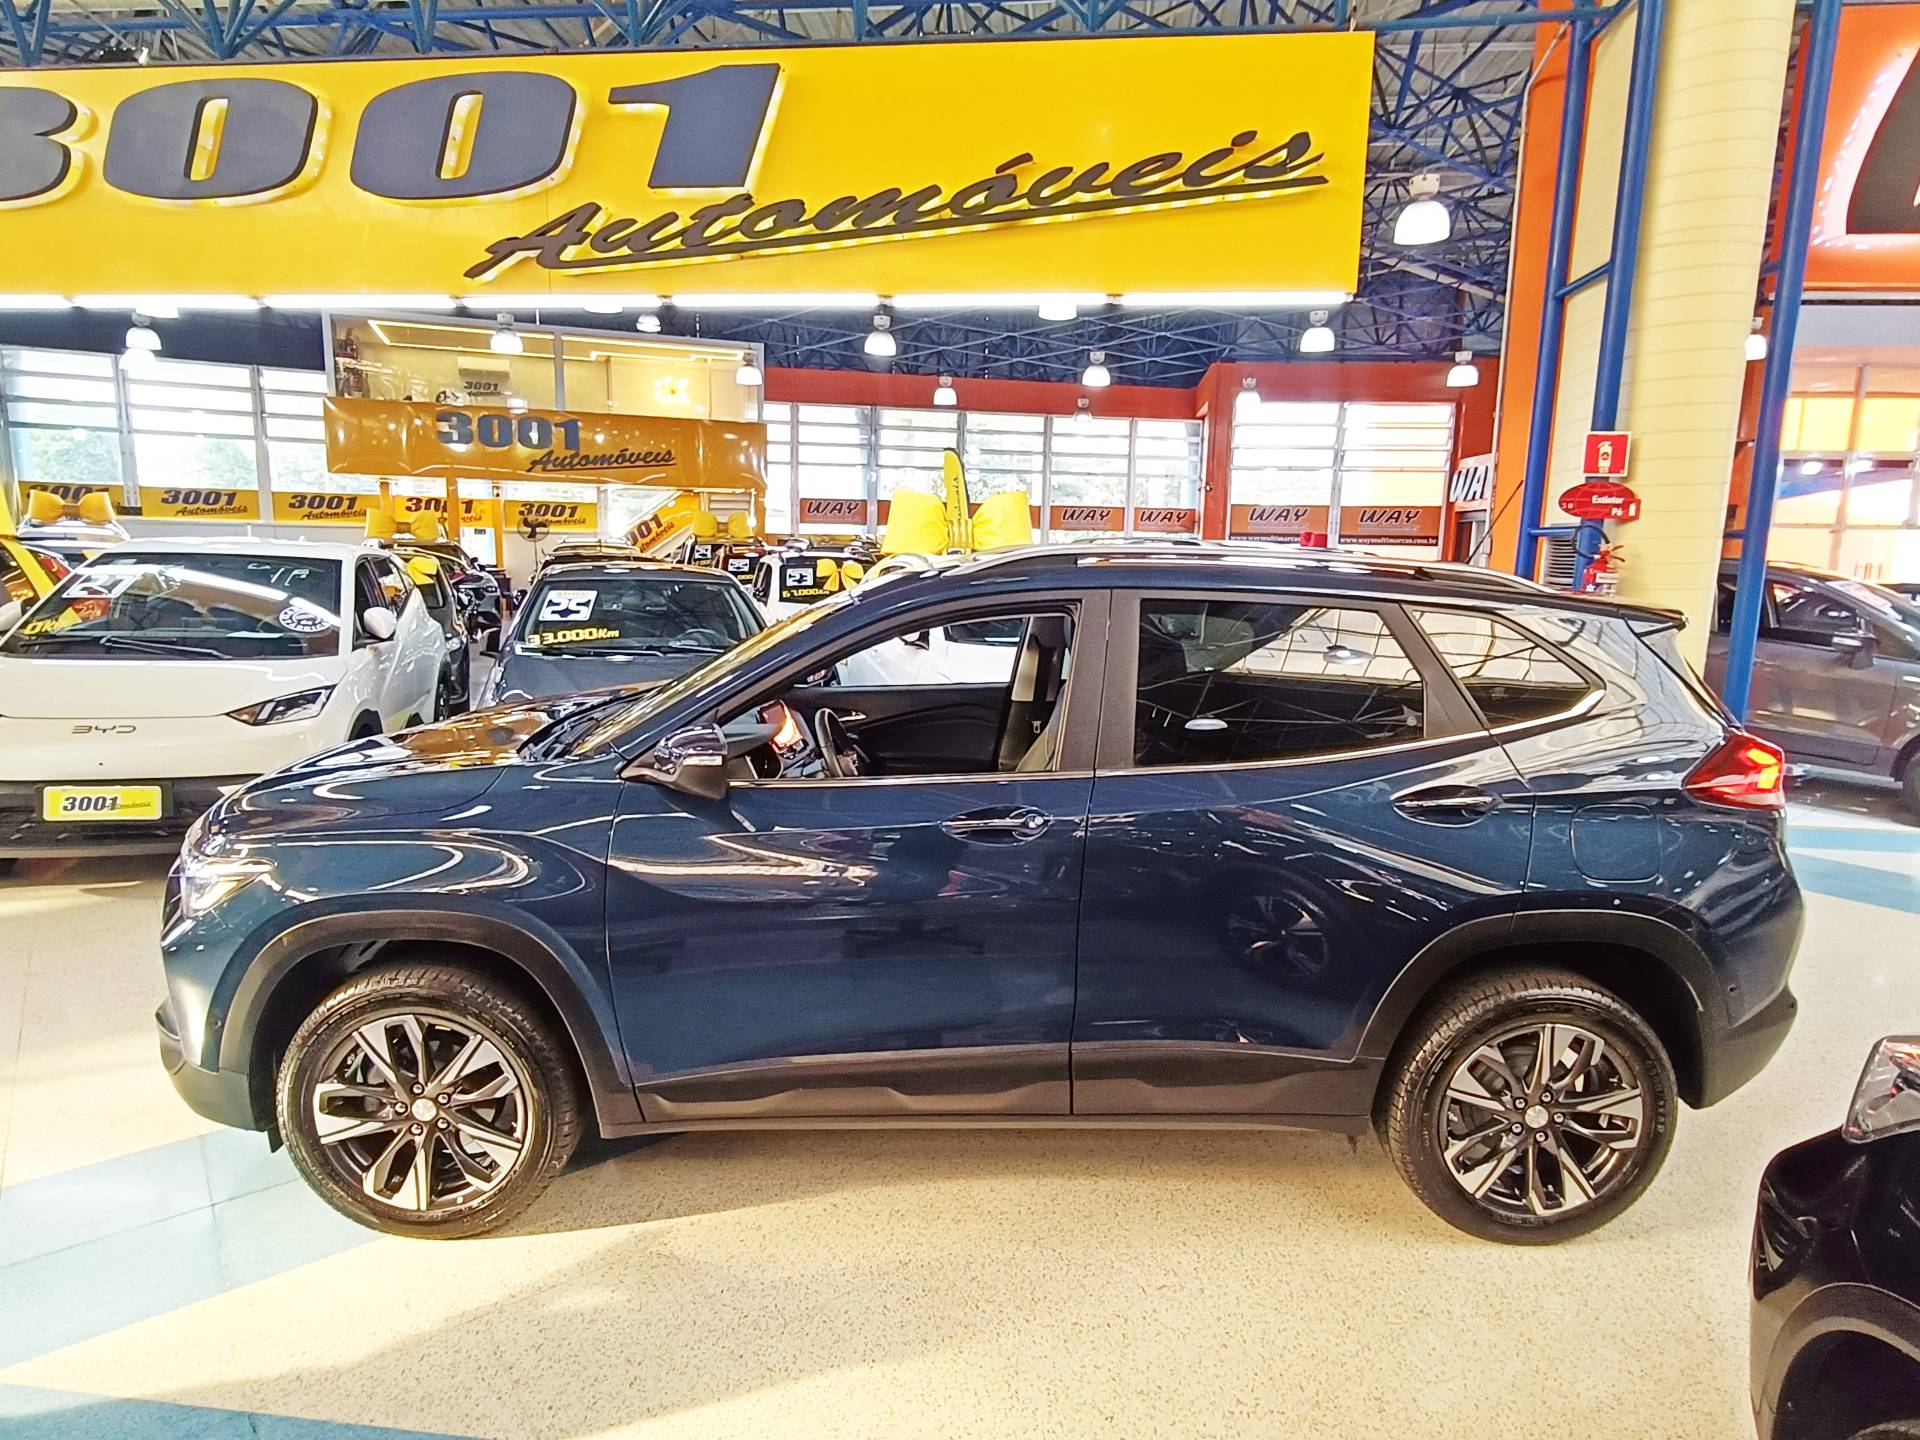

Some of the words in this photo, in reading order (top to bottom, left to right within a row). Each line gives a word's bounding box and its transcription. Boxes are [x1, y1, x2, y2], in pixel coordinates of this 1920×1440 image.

[463, 129, 1328, 279] Automóveis
[463, 380, 499, 392] 3001
[436, 411, 581, 453] 3001
[526, 448, 677, 473] Automóveis
[161, 489, 237, 506] 3001
[288, 494, 359, 510] 3001
[1591, 494, 1625, 504] Extintor
[174, 504, 248, 517] Automóveis
[518, 502, 579, 518] 3001
[807, 501, 860, 514] WAY
[1062, 509, 1112, 521] WAY
[1248, 507, 1309, 522] WAY
[1139, 510, 1188, 523] WAY
[1359, 509, 1421, 523] WAY
[544, 598, 593, 619] 25
[71, 724, 137, 734] BYD
[62, 796, 119, 812] 3001
